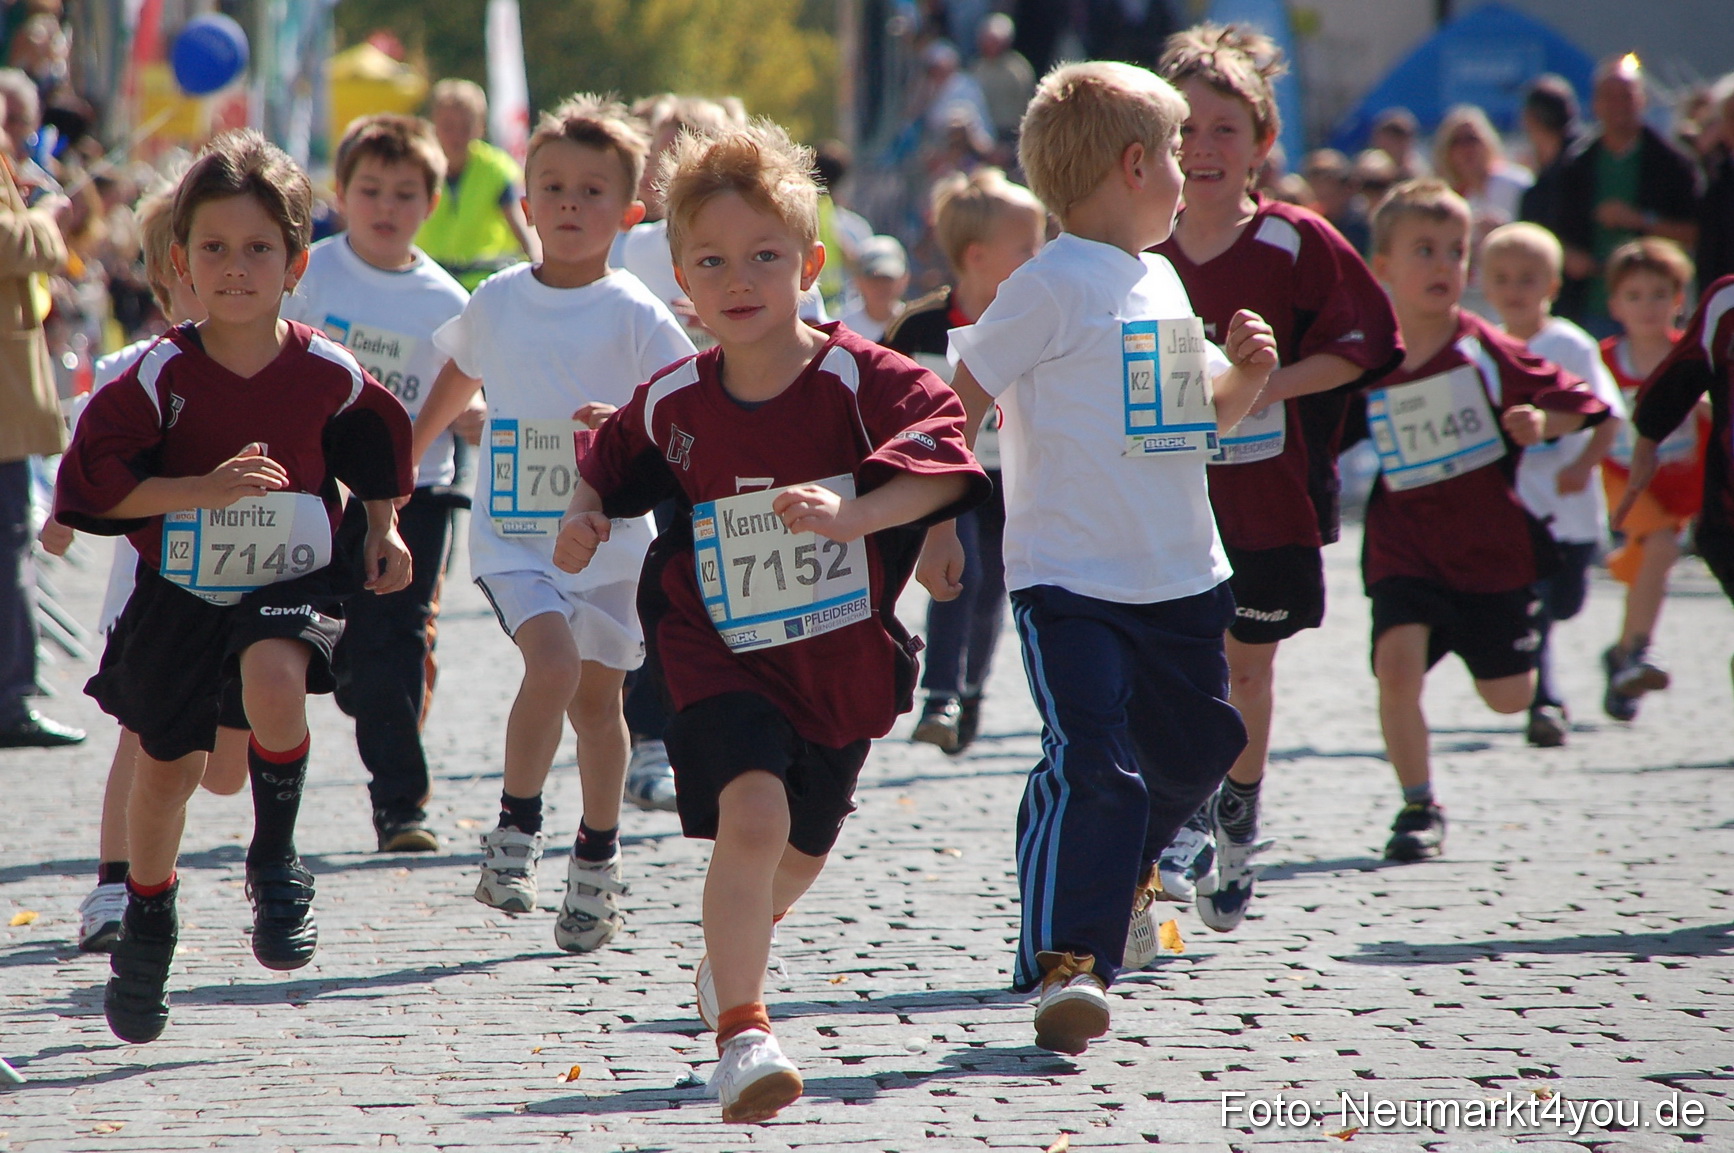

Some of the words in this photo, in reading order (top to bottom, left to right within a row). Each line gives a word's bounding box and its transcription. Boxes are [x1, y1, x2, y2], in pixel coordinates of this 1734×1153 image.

[1131, 371, 1150, 391] K2
[525, 427, 560, 449] Finn
[1400, 407, 1482, 451] 7148
[496, 463, 511, 480] K2
[209, 504, 276, 527] Moritz
[169, 541, 189, 559] K2
[211, 543, 315, 575] 7149
[701, 560, 717, 583] K2
[732, 540, 852, 598] 7152
[804, 598, 867, 626] PFLEIDERER
